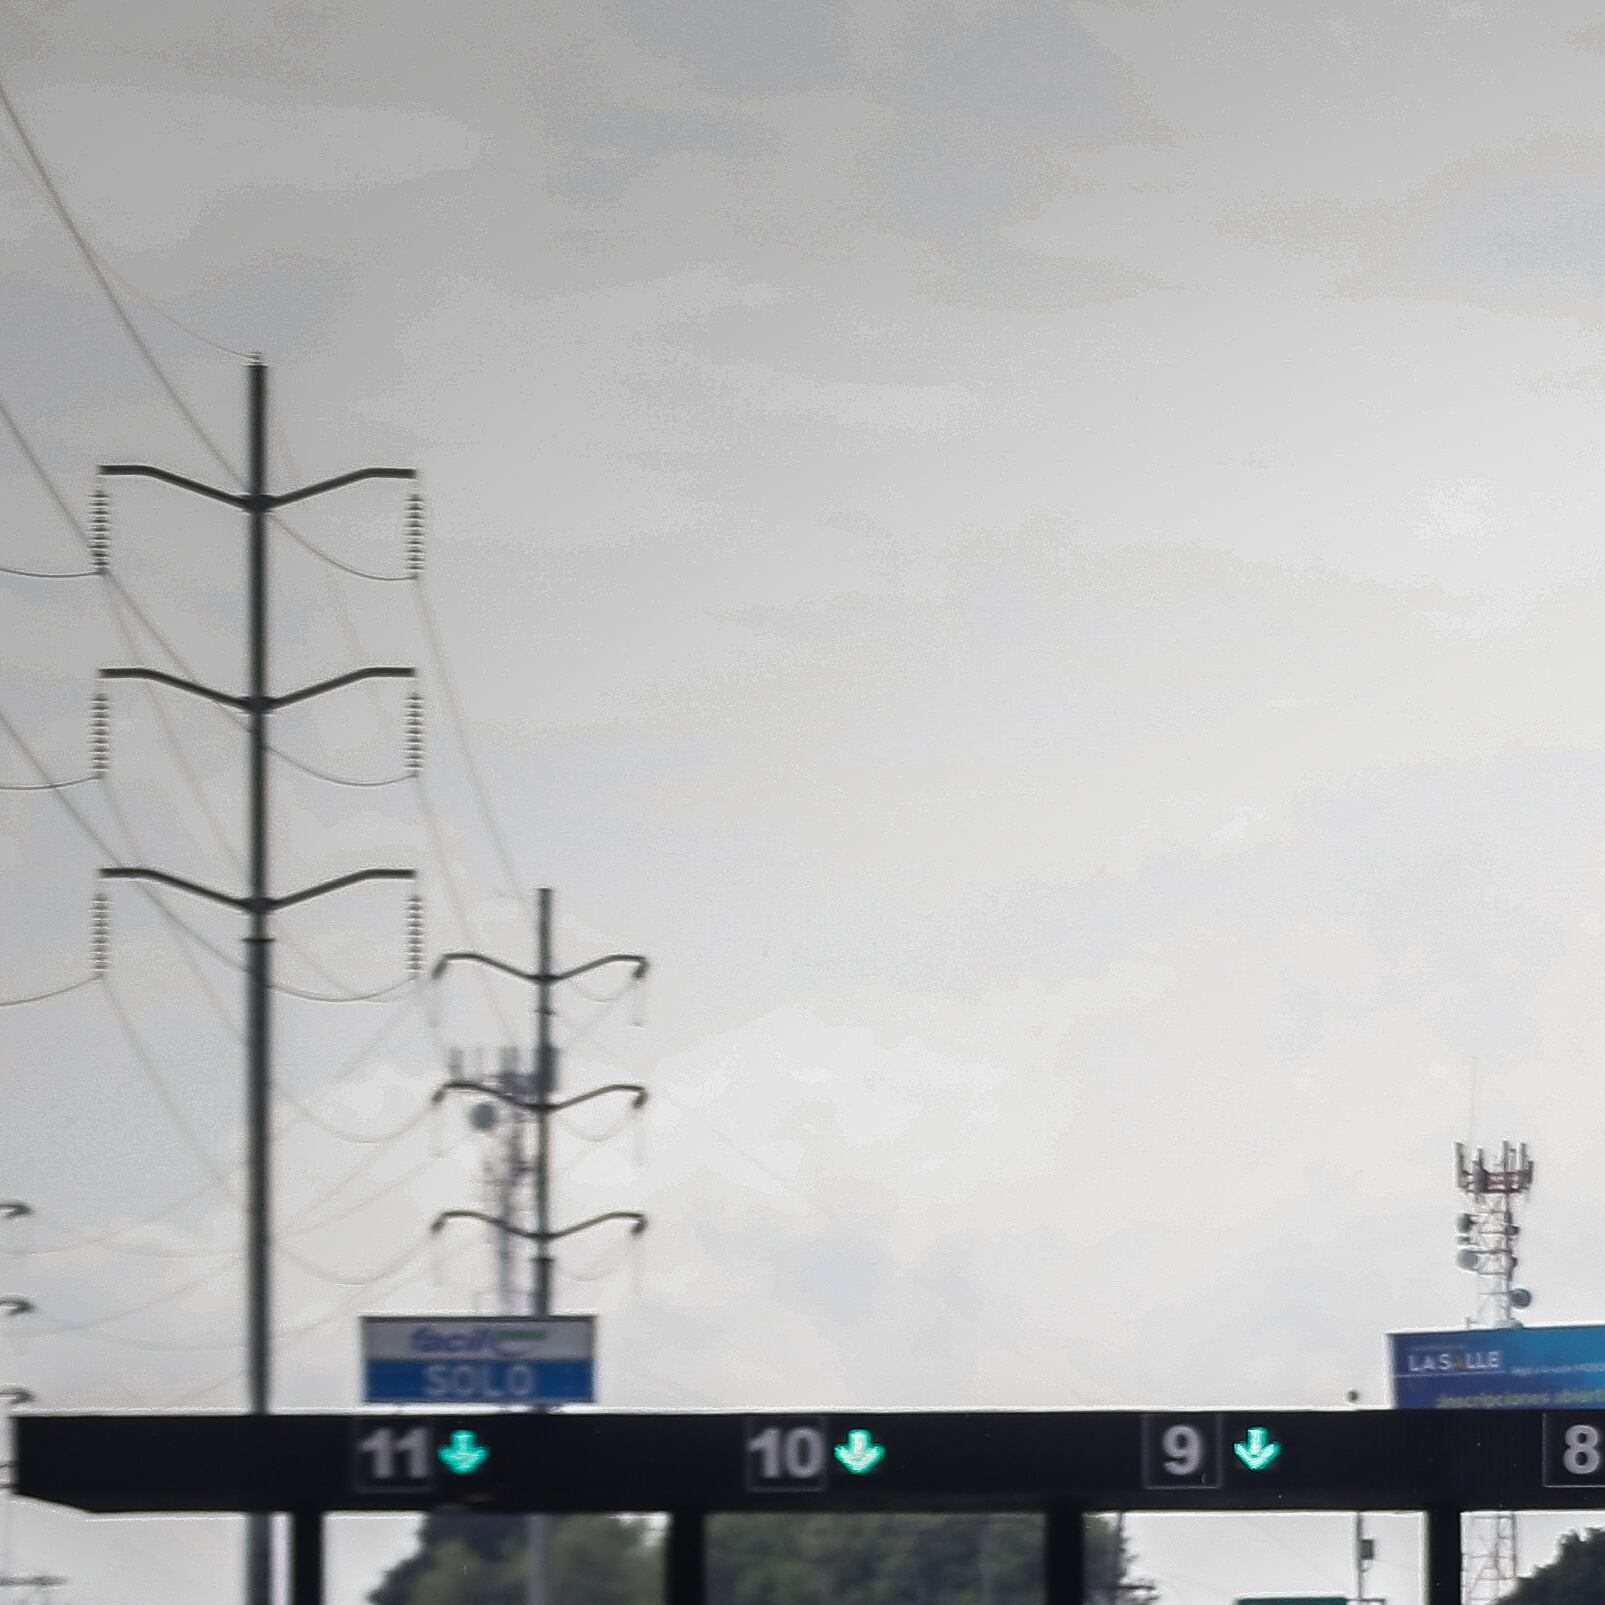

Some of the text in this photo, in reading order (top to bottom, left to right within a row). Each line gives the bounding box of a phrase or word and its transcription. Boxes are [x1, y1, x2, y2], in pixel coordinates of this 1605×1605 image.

[422, 1364, 534, 1398] SOLO
[359, 1426, 431, 1479] 11
[747, 1427, 825, 1479] 10
[1162, 1424, 1202, 1476] 9
[1562, 1424, 1600, 1475] 8
